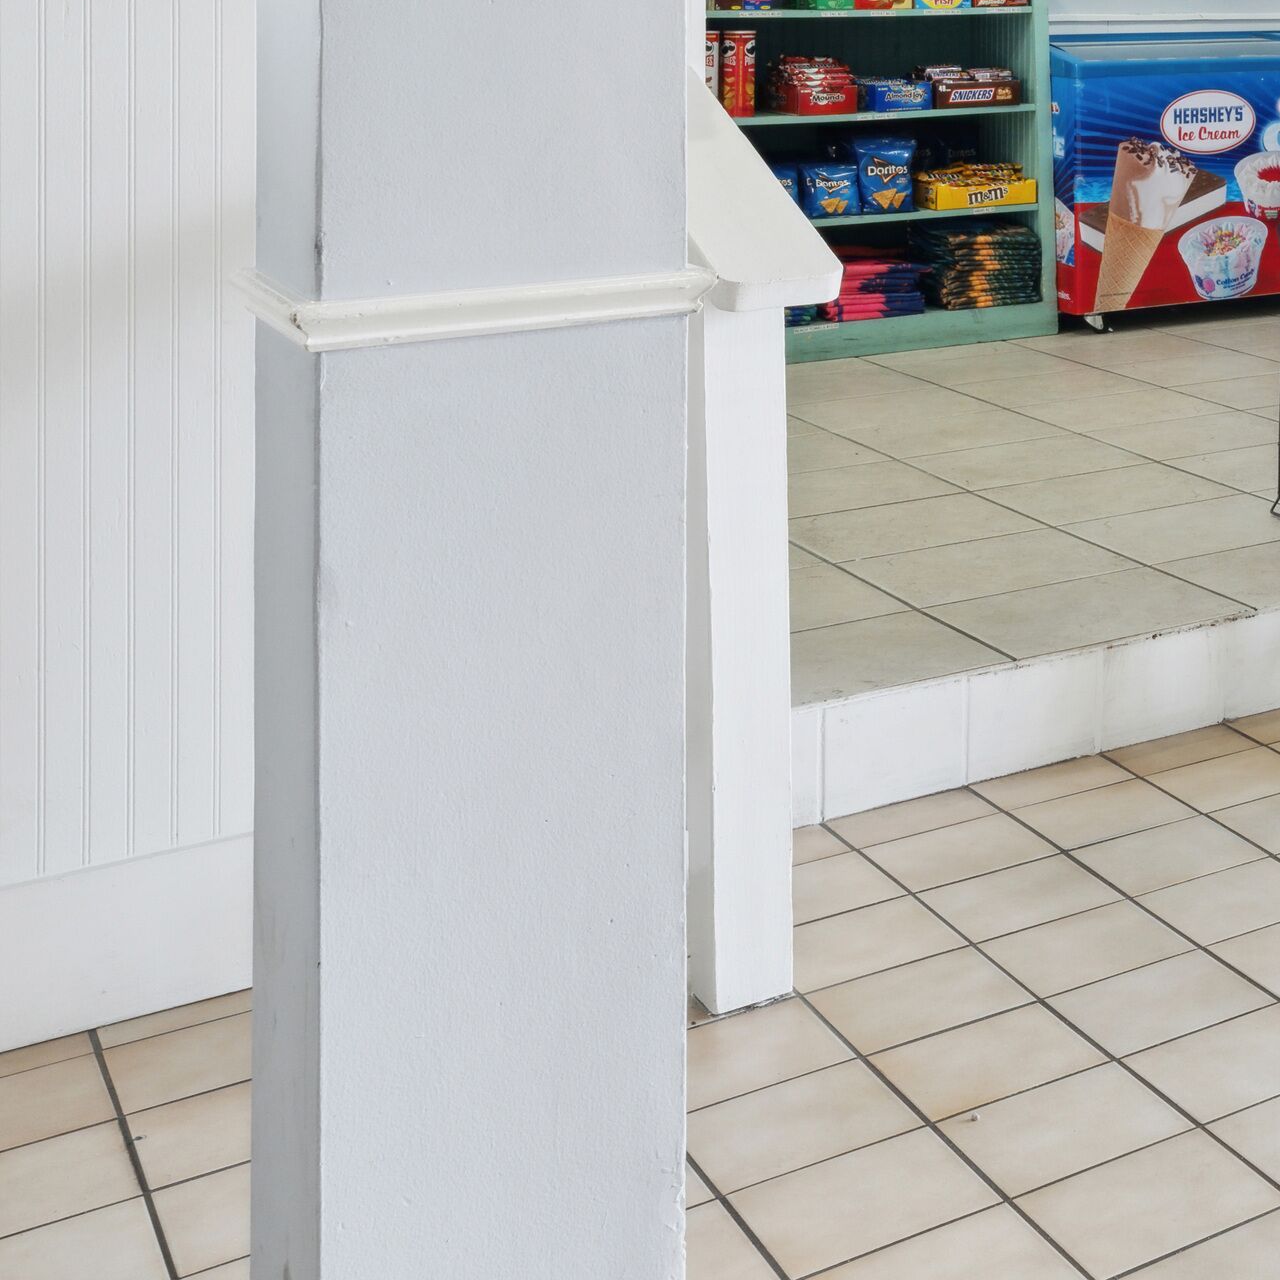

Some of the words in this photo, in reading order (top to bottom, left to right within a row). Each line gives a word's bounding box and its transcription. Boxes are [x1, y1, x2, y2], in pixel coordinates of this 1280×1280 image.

[812, 94, 844, 102] Mounds
[885, 92, 912, 100] Almond
[911, 90, 925, 102] Joy
[952, 89, 993, 101] SNICKERS
[1173, 106, 1245, 125] HERSHEY'S
[1178, 127, 1195, 141] Ice
[1199, 126, 1241, 140] Cream
[867, 164, 908, 176] Doritos
[815, 178, 849, 188] Doritos
